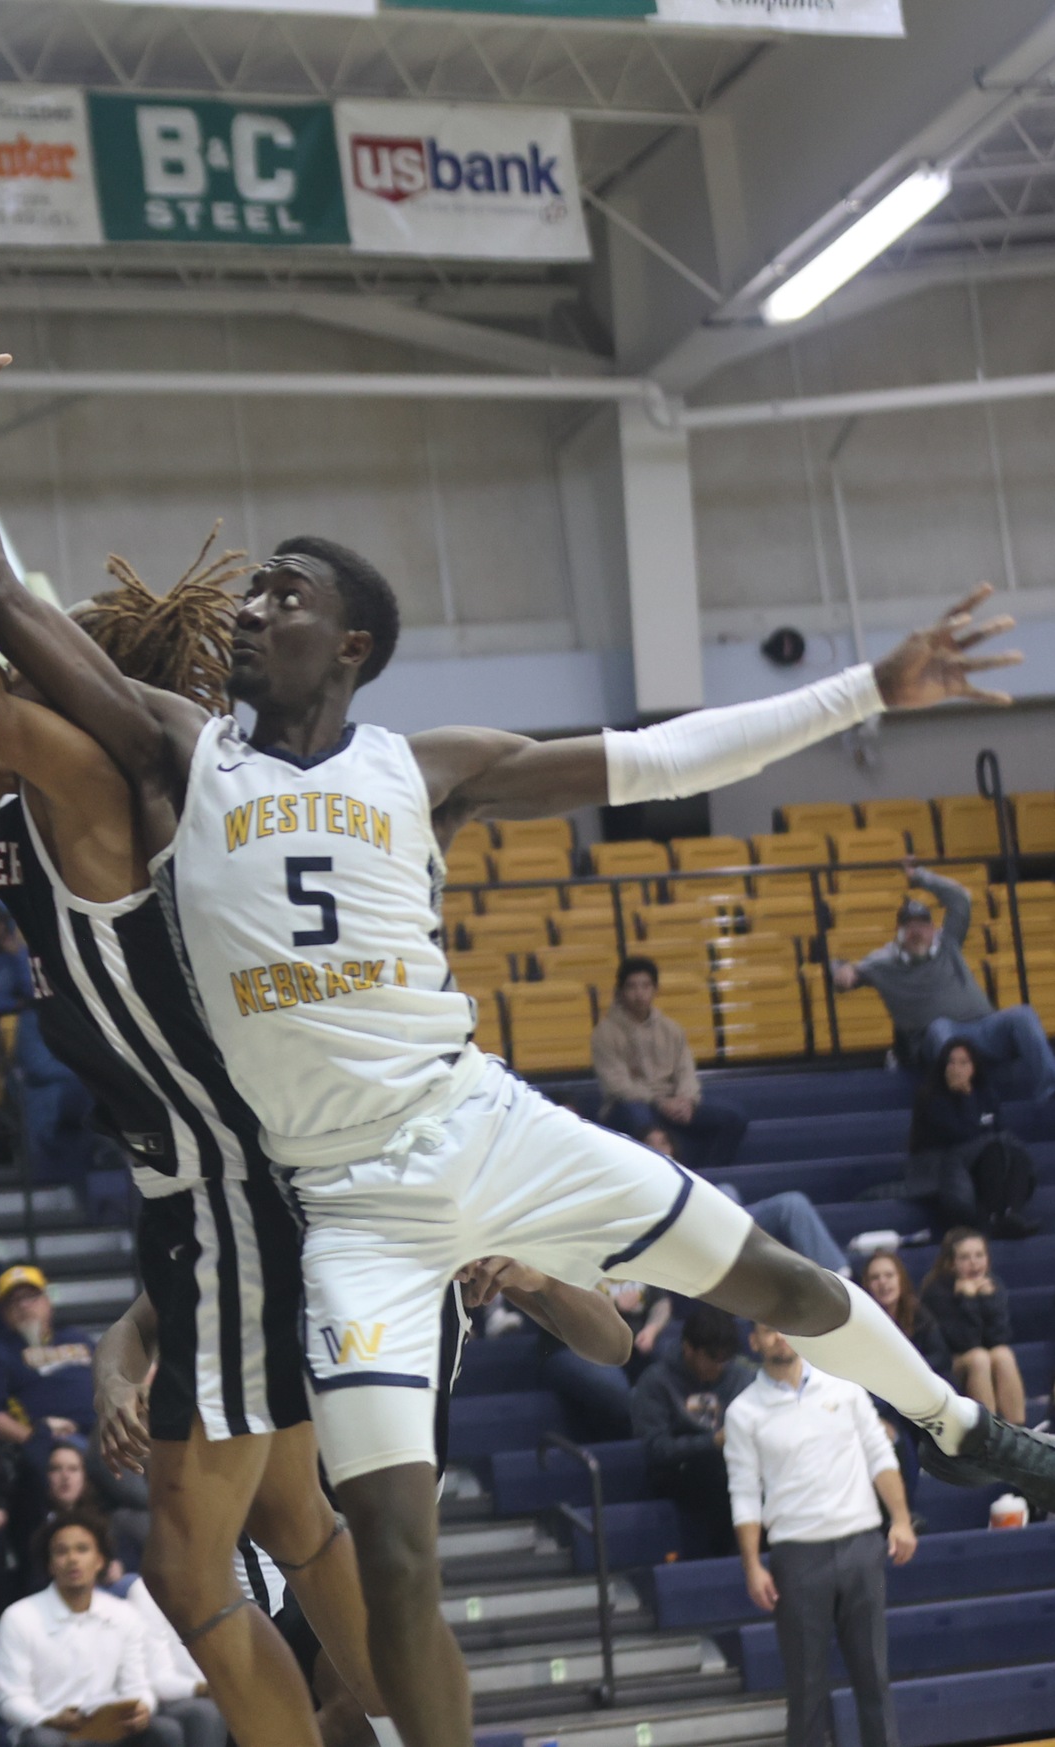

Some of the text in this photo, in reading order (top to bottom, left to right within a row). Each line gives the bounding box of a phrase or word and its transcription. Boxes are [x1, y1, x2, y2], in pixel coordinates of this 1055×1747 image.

[136, 105, 296, 203] B&C
[146, 199, 304, 236] STEEL
[223, 791, 392, 856] WESTERN
[284, 856, 339, 947] 5
[229, 956, 408, 1017] NEBRASKA
